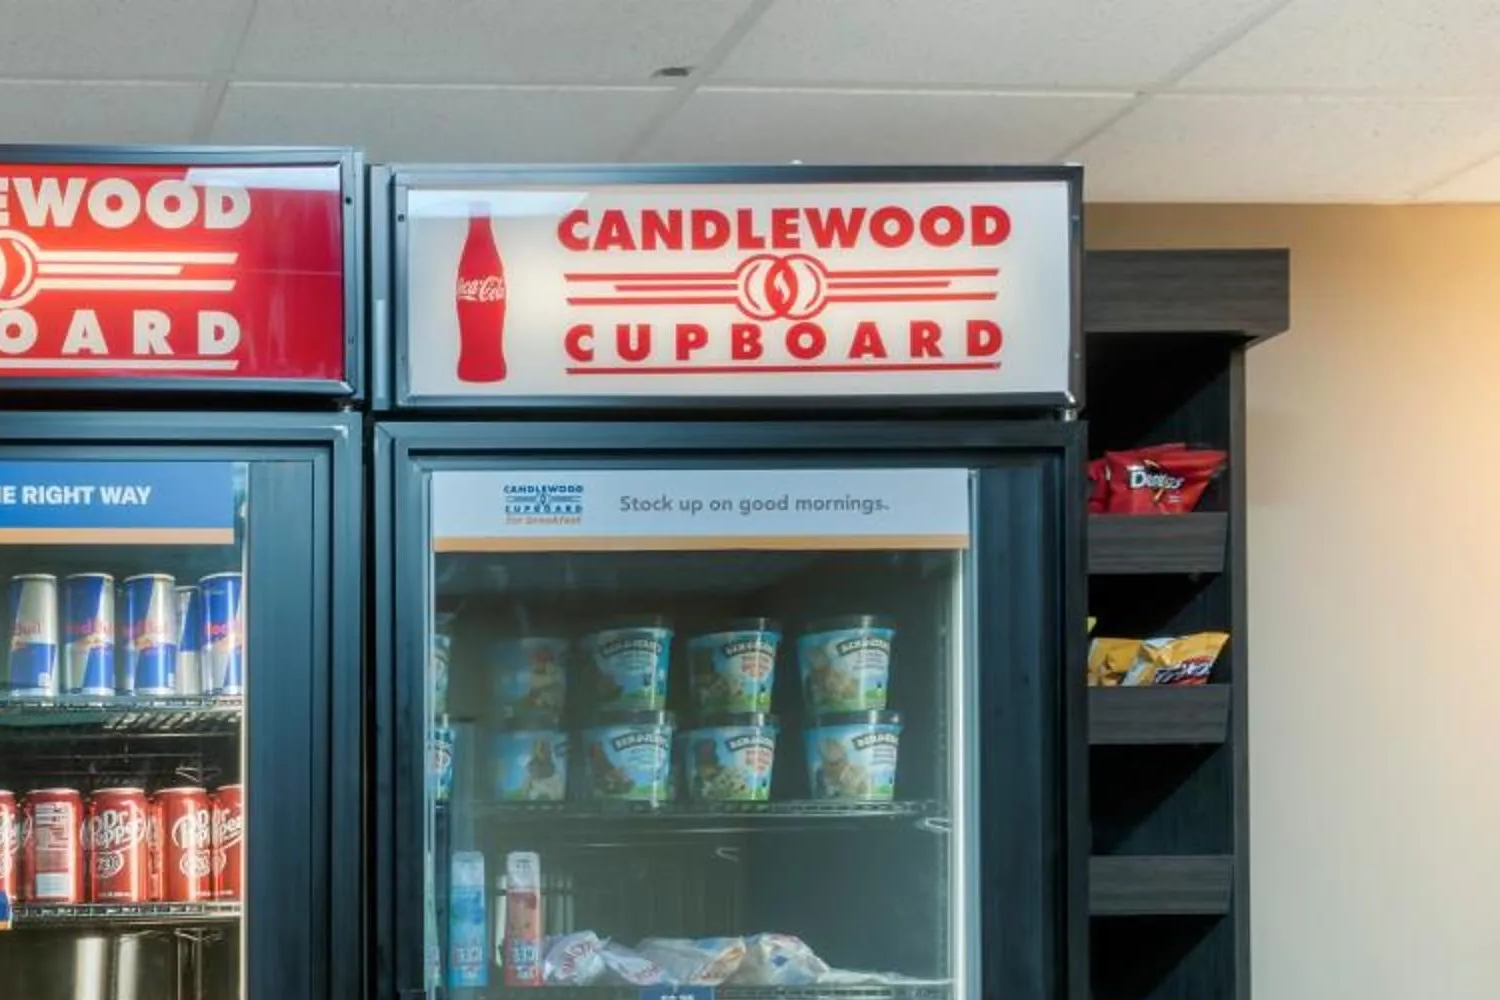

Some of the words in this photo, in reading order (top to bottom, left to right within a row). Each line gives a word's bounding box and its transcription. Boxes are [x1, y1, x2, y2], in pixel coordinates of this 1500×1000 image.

[558, 205, 1011, 251] CANDLEWOOD
[564, 320, 1003, 361] CUPBOARD
[22, 485, 94, 505] RIGHT
[100, 486, 152, 505] WAY
[503, 484, 584, 494] CANDLEWOOD
[505, 504, 583, 513] CUPBOARD
[619, 495, 672, 512] Stock
[679, 498, 703, 516] up
[709, 499, 733, 512] on
[739, 495, 789, 516] good
[795, 495, 890, 515] mornings.
